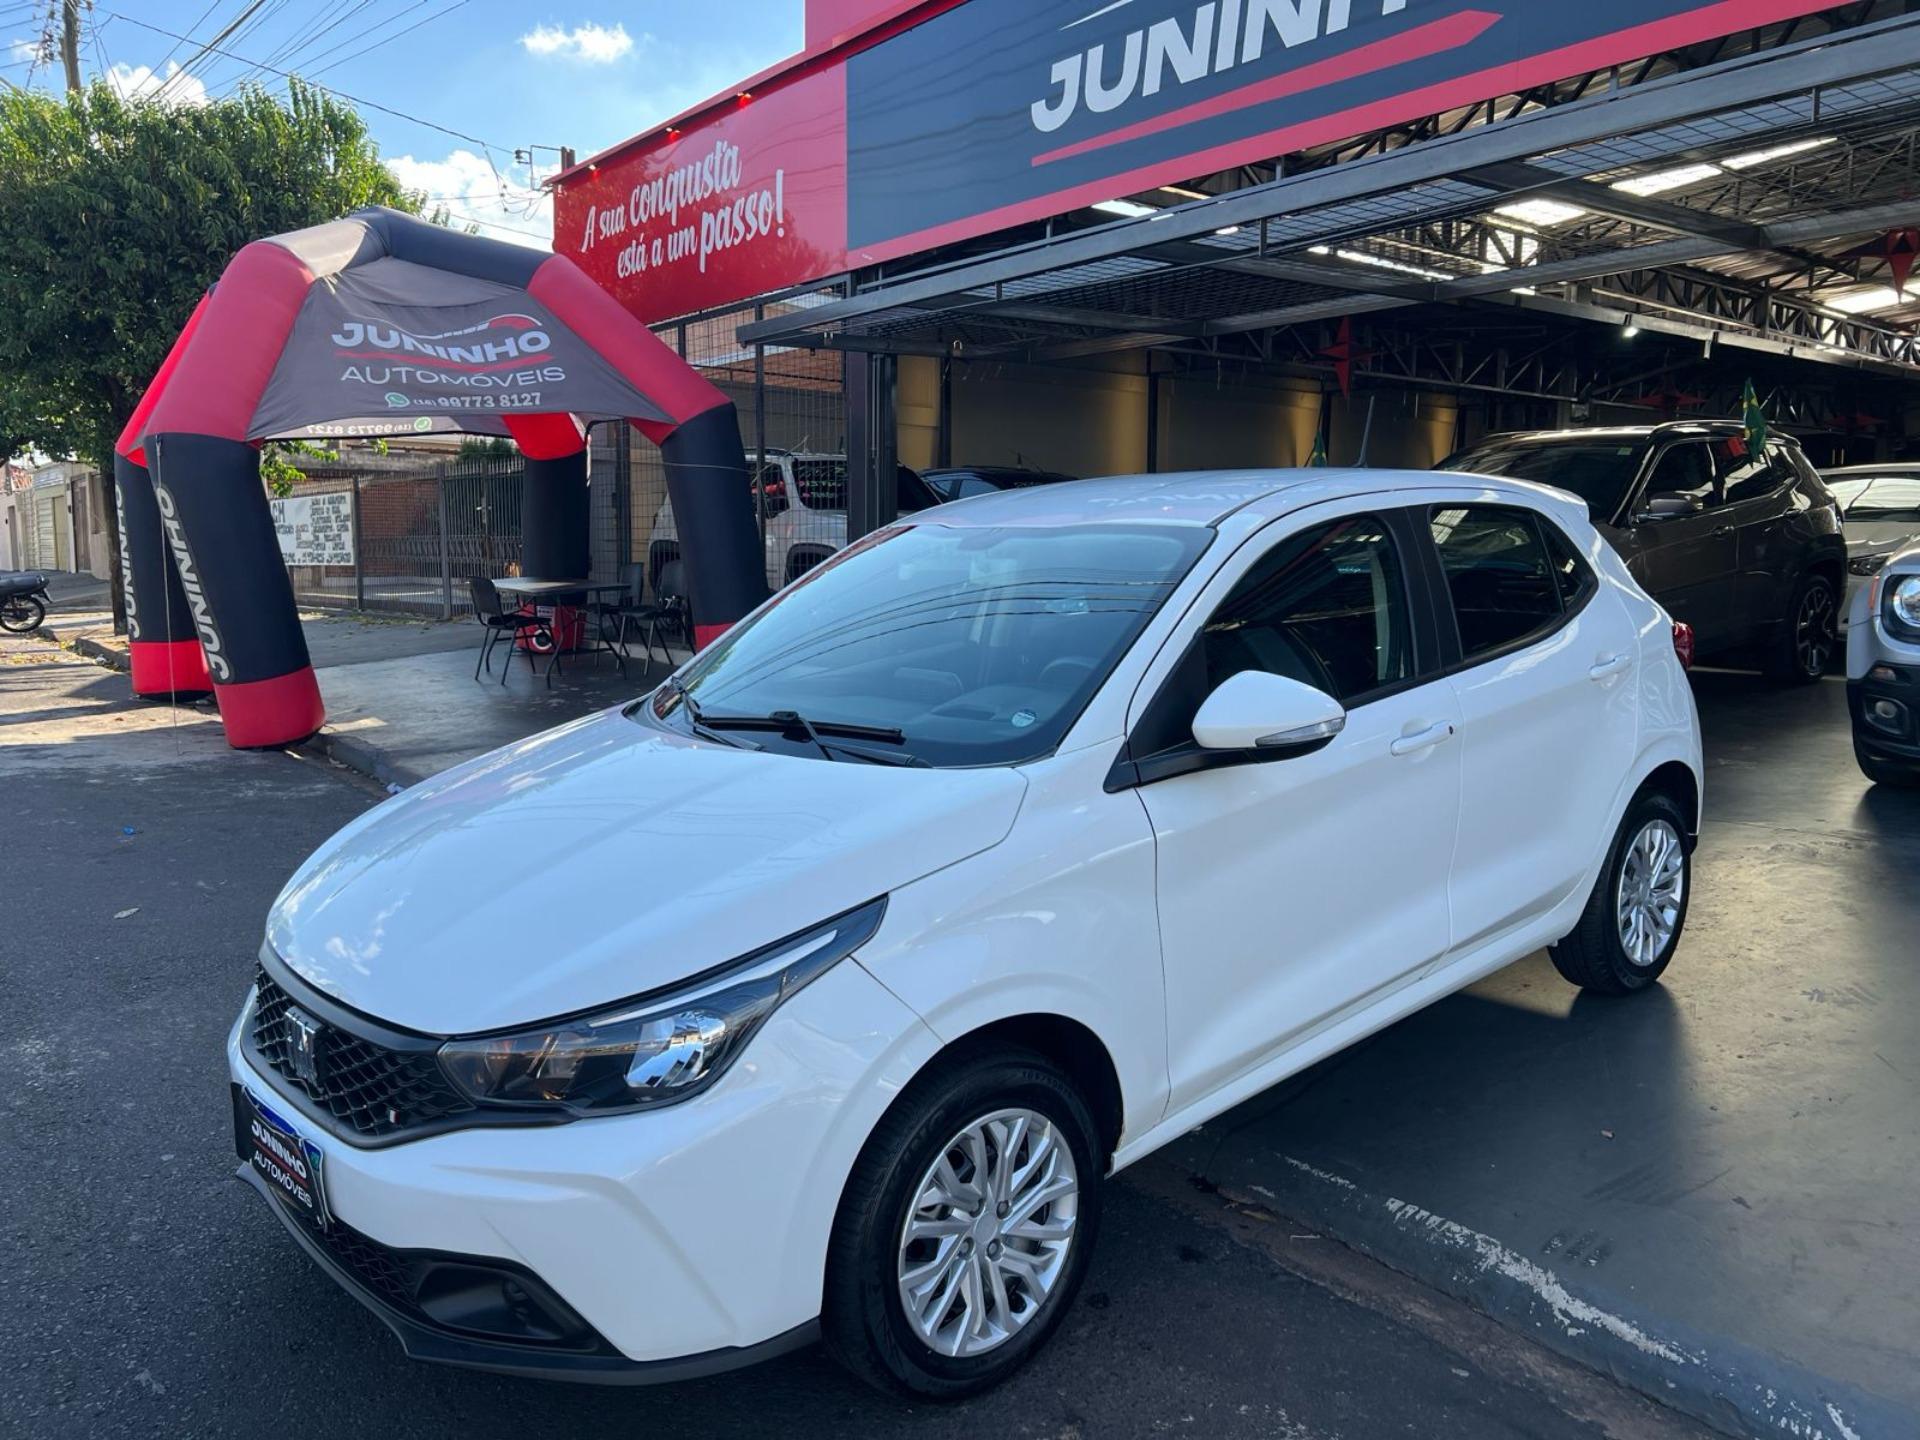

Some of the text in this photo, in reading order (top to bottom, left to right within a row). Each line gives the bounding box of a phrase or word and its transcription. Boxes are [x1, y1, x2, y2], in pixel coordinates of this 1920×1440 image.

[581, 140, 742, 253] A sua conquista
[617, 169, 784, 279] está a um passo!
[331, 322, 551, 364] JUNINHO
[341, 365, 567, 388] AUTOMÓVEIS
[438, 396, 496, 408] 99773
[500, 392, 541, 408] 8127
[157, 487, 230, 681] JUNINHO
[252, 1119, 307, 1179] JUNINHO
[254, 1150, 313, 1208] AUTOMÓVEIS
